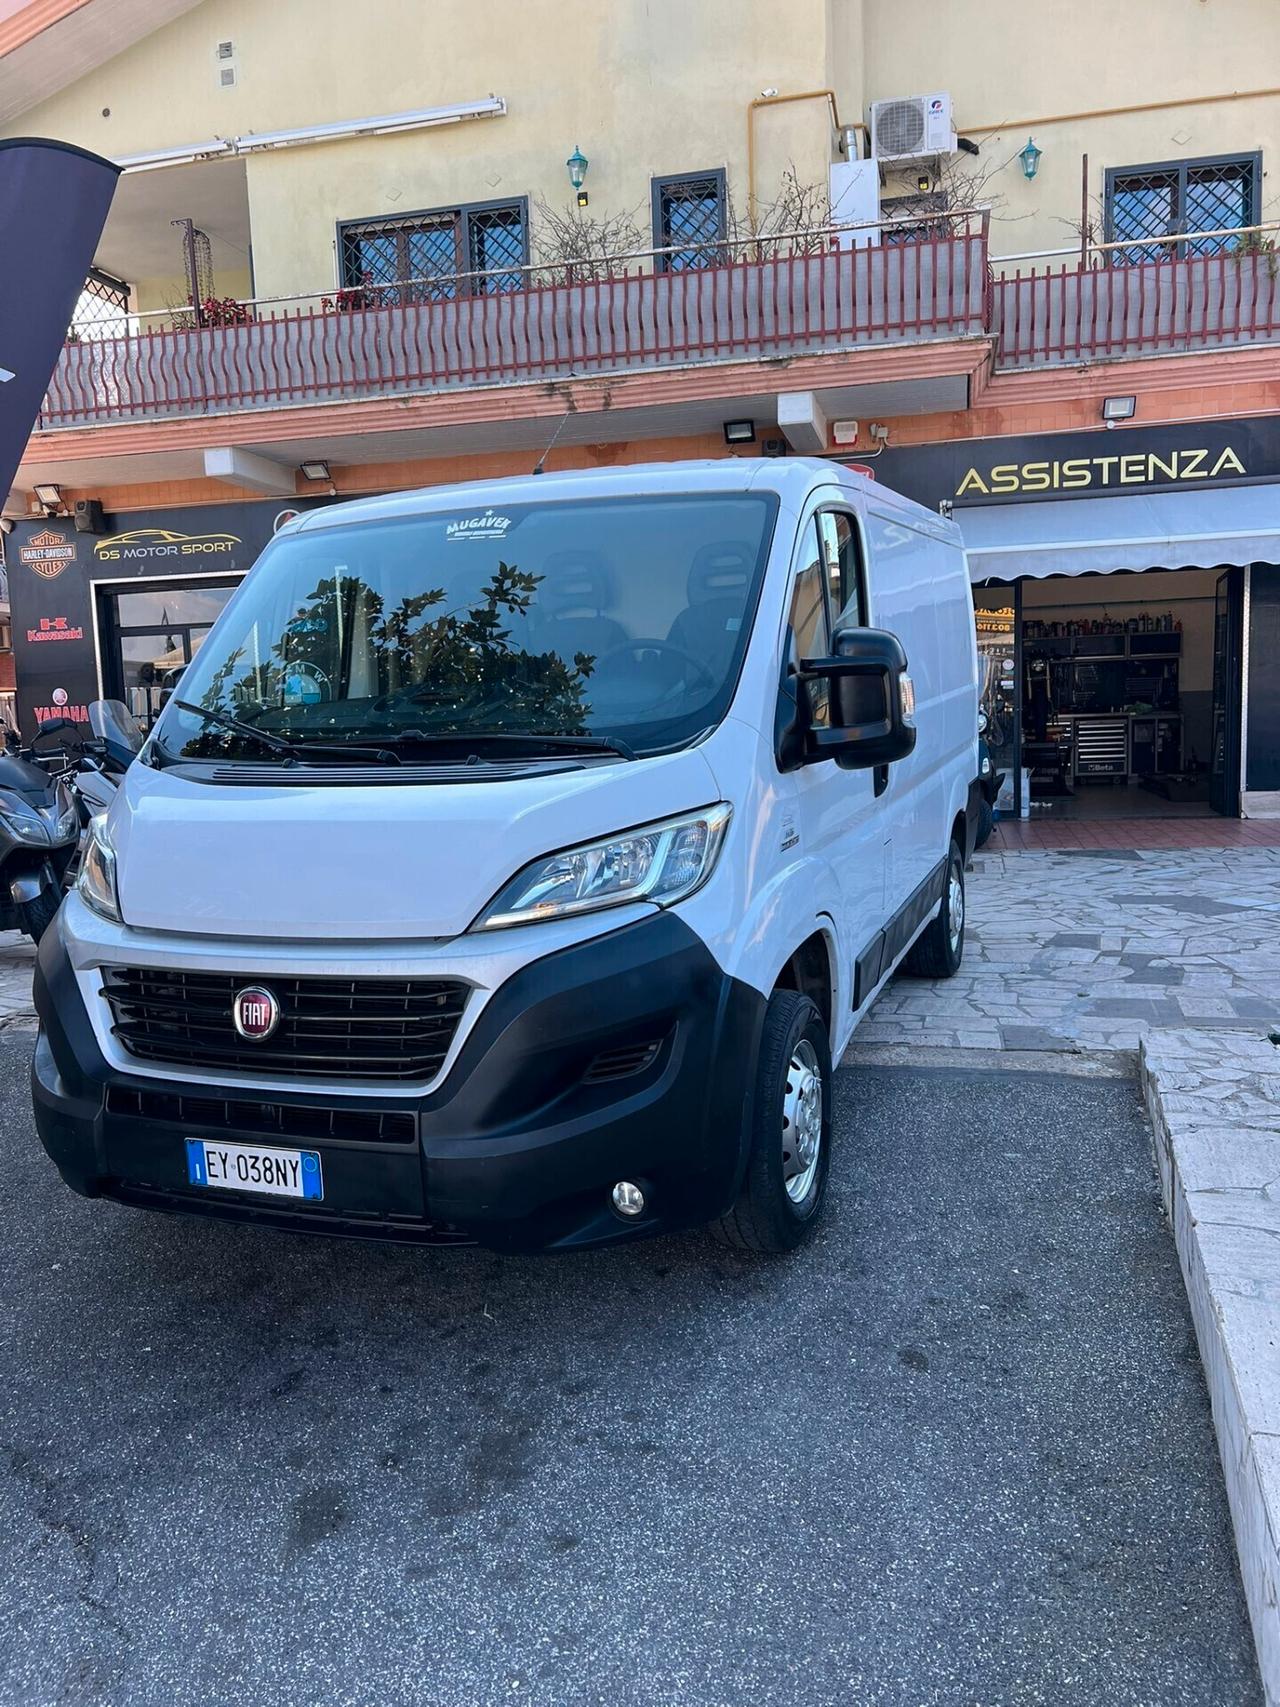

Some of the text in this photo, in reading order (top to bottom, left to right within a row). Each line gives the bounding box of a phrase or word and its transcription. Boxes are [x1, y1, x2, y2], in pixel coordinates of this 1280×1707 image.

[955, 446, 1247, 496] ASSISTENZA
[33, 533, 60, 546] MOTOR
[23, 547, 73, 560] HARLEY-DAVIDSON
[100, 541, 235, 560] DS MOTOR SPORT
[35, 561, 62, 575] CYCLES
[27, 627, 83, 642] Kawasaki
[33, 705, 90, 724] YAMAHA
[243, 1002, 268, 1026] FIAT
